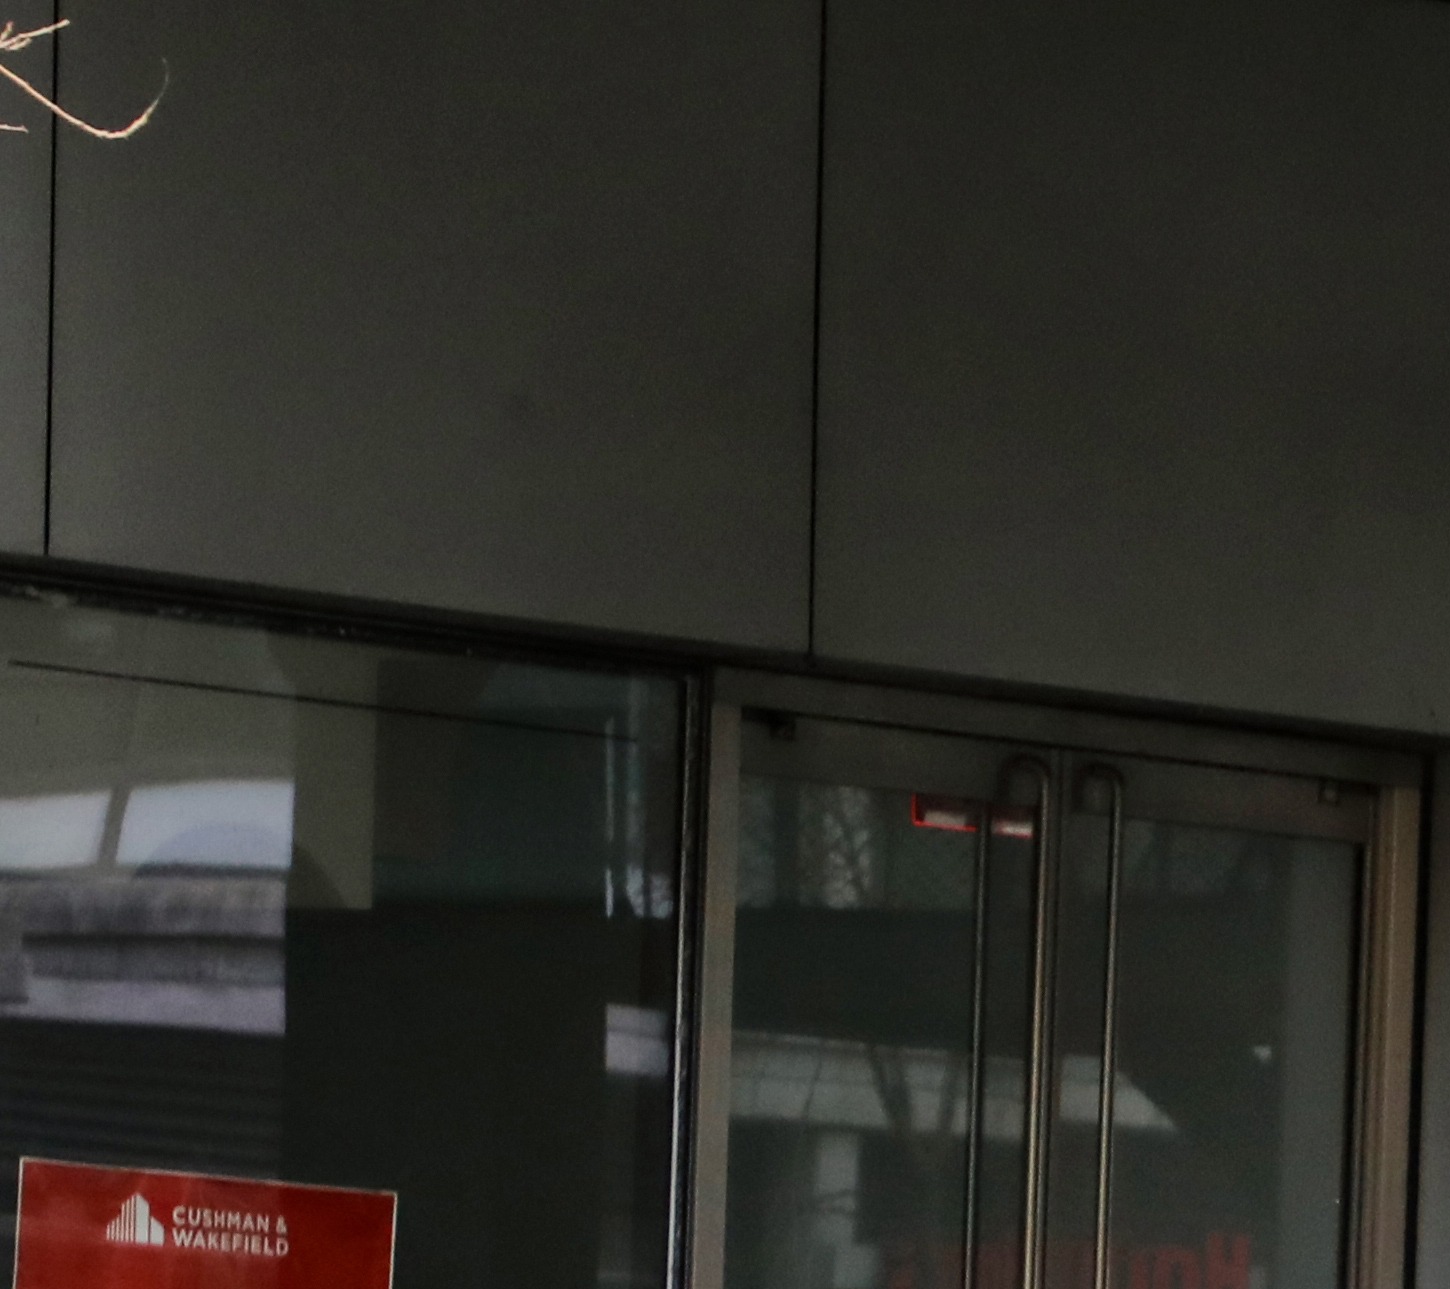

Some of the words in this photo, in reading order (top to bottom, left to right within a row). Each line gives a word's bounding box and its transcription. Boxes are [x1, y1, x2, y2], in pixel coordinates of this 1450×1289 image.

[172, 1205, 270, 1233] CUSHMAN
[276, 1215, 288, 1234] &
[172, 1228, 289, 1257] WAKEFIELD
